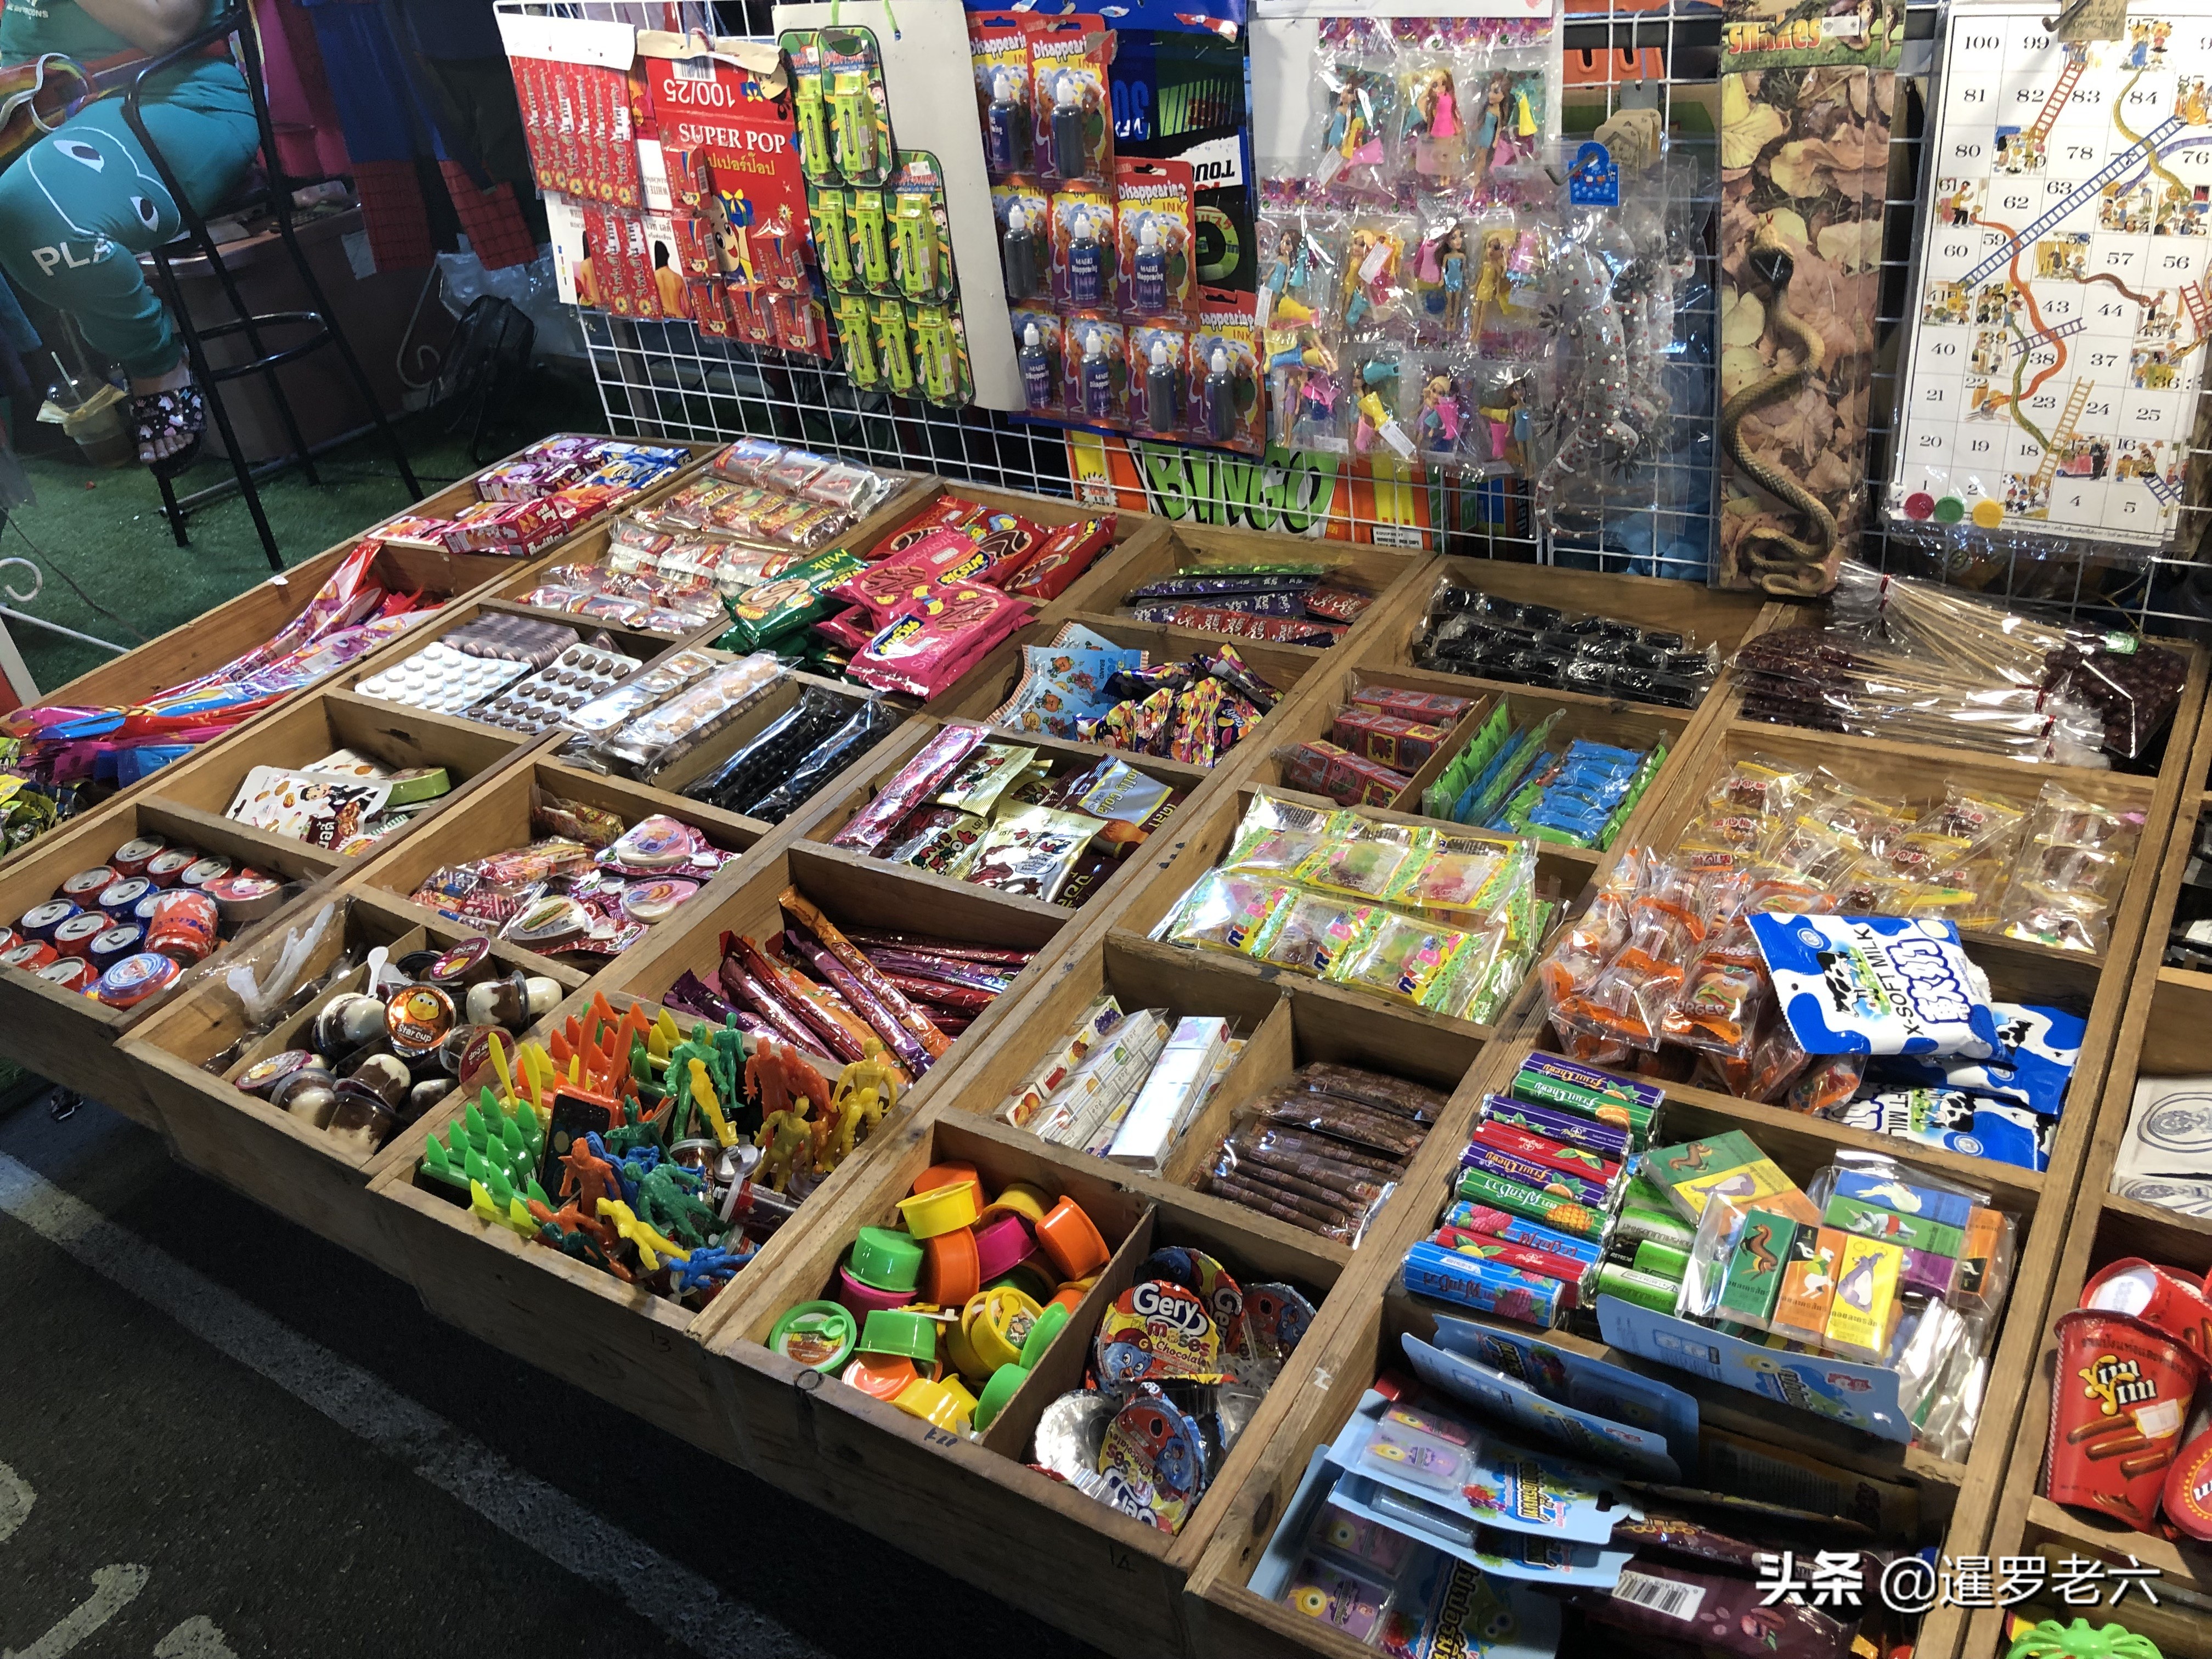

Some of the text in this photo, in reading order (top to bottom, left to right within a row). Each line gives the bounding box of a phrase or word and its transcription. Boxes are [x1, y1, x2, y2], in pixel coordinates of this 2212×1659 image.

[970, 33, 1026, 57] Disappeari
[1965, 36, 1999, 50] 100
[2023, 36, 2050, 50] 99
[2127, 18, 2154, 31] 97
[1033, 36, 1087, 62] Disappeari
[664, 79, 735, 108] 100/25
[1964, 89, 1985, 102] 81
[2017, 89, 2044, 103] 82
[2072, 90, 2100, 103] 83
[2129, 91, 2157, 105] 84
[679, 123, 785, 154] SUPER POP
[1955, 144, 1980, 157] 80
[2067, 146, 2093, 160] 78
[2183, 151, 2210, 165] 76
[1194, 160, 1235, 180] TOU
[1939, 179, 1957, 192] 61
[2004, 196, 2029, 210] 62
[2047, 182, 2072, 195] 63
[569, 209, 584, 219] WHIT
[1162, 201, 1183, 213] INK
[1944, 245, 1968, 257] 60
[1983, 233, 2006, 245] 59
[2107, 252, 2134, 266] 57
[2163, 256, 2190, 270] 56
[2042, 300, 2070, 313] 43
[2097, 304, 2125, 318] 44
[1234, 330, 1252, 342] INK
[1931, 343, 1956, 356] 40
[2030, 352, 2055, 365] 38
[2091, 354, 2118, 367] 37
[1926, 377, 2160, 421] 21 22 23 24 25
[1920, 436, 1942, 448] 20
[1971, 439, 1989, 452] 19
[2020, 444, 2039, 457] 18
[2117, 439, 2136, 452] 16
[1136, 441, 1339, 532] BINGO
[2070, 495, 2080, 507] 4
[2124, 501, 2136, 514] 5
[813, 548, 850, 572] Milk
[1708, 945, 1759, 957] BURGE
[1853, 928, 1924, 1036] X-SOFT MILK
[396, 1022, 432, 1044] Star cup
[1533, 1081, 1600, 1110] Fruit Chewy
[1888, 1111, 1909, 1136] MIL
[1484, 1150, 1550, 1182] Fruit Chewy
[1133, 1282, 1199, 1318] Gery
[1156, 1340, 1207, 1365] Chocolate
